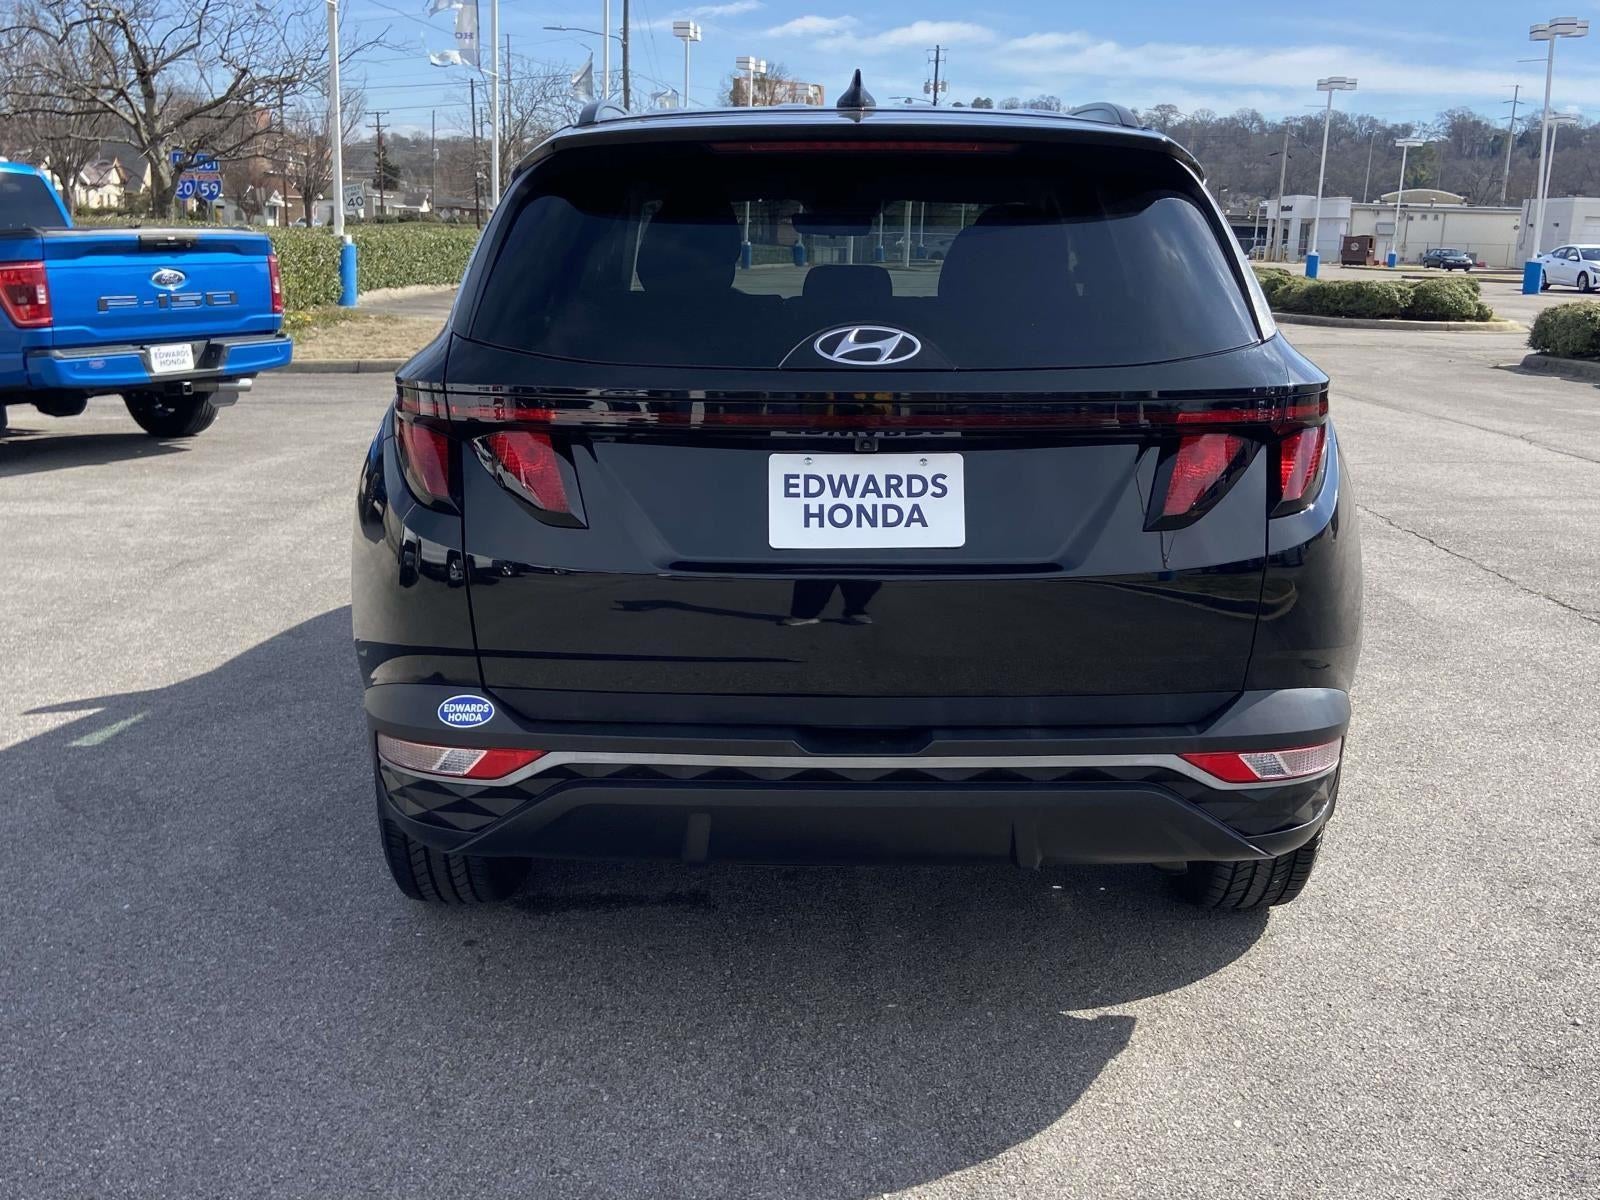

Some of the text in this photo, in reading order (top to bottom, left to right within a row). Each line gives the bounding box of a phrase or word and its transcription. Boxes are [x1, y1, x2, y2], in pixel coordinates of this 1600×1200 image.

[175, 182, 193, 195] 20
[201, 183, 219, 196] 59
[348, 196, 363, 207] 40
[97, 291, 239, 314] F-150
[154, 349, 190, 359] EDWARDS
[160, 358, 187, 367] HONDA
[783, 473, 948, 498] EDWARDS
[803, 503, 928, 529] HONDA
[444, 704, 489, 712] EDWARDS
[448, 713, 482, 721] HONDA
